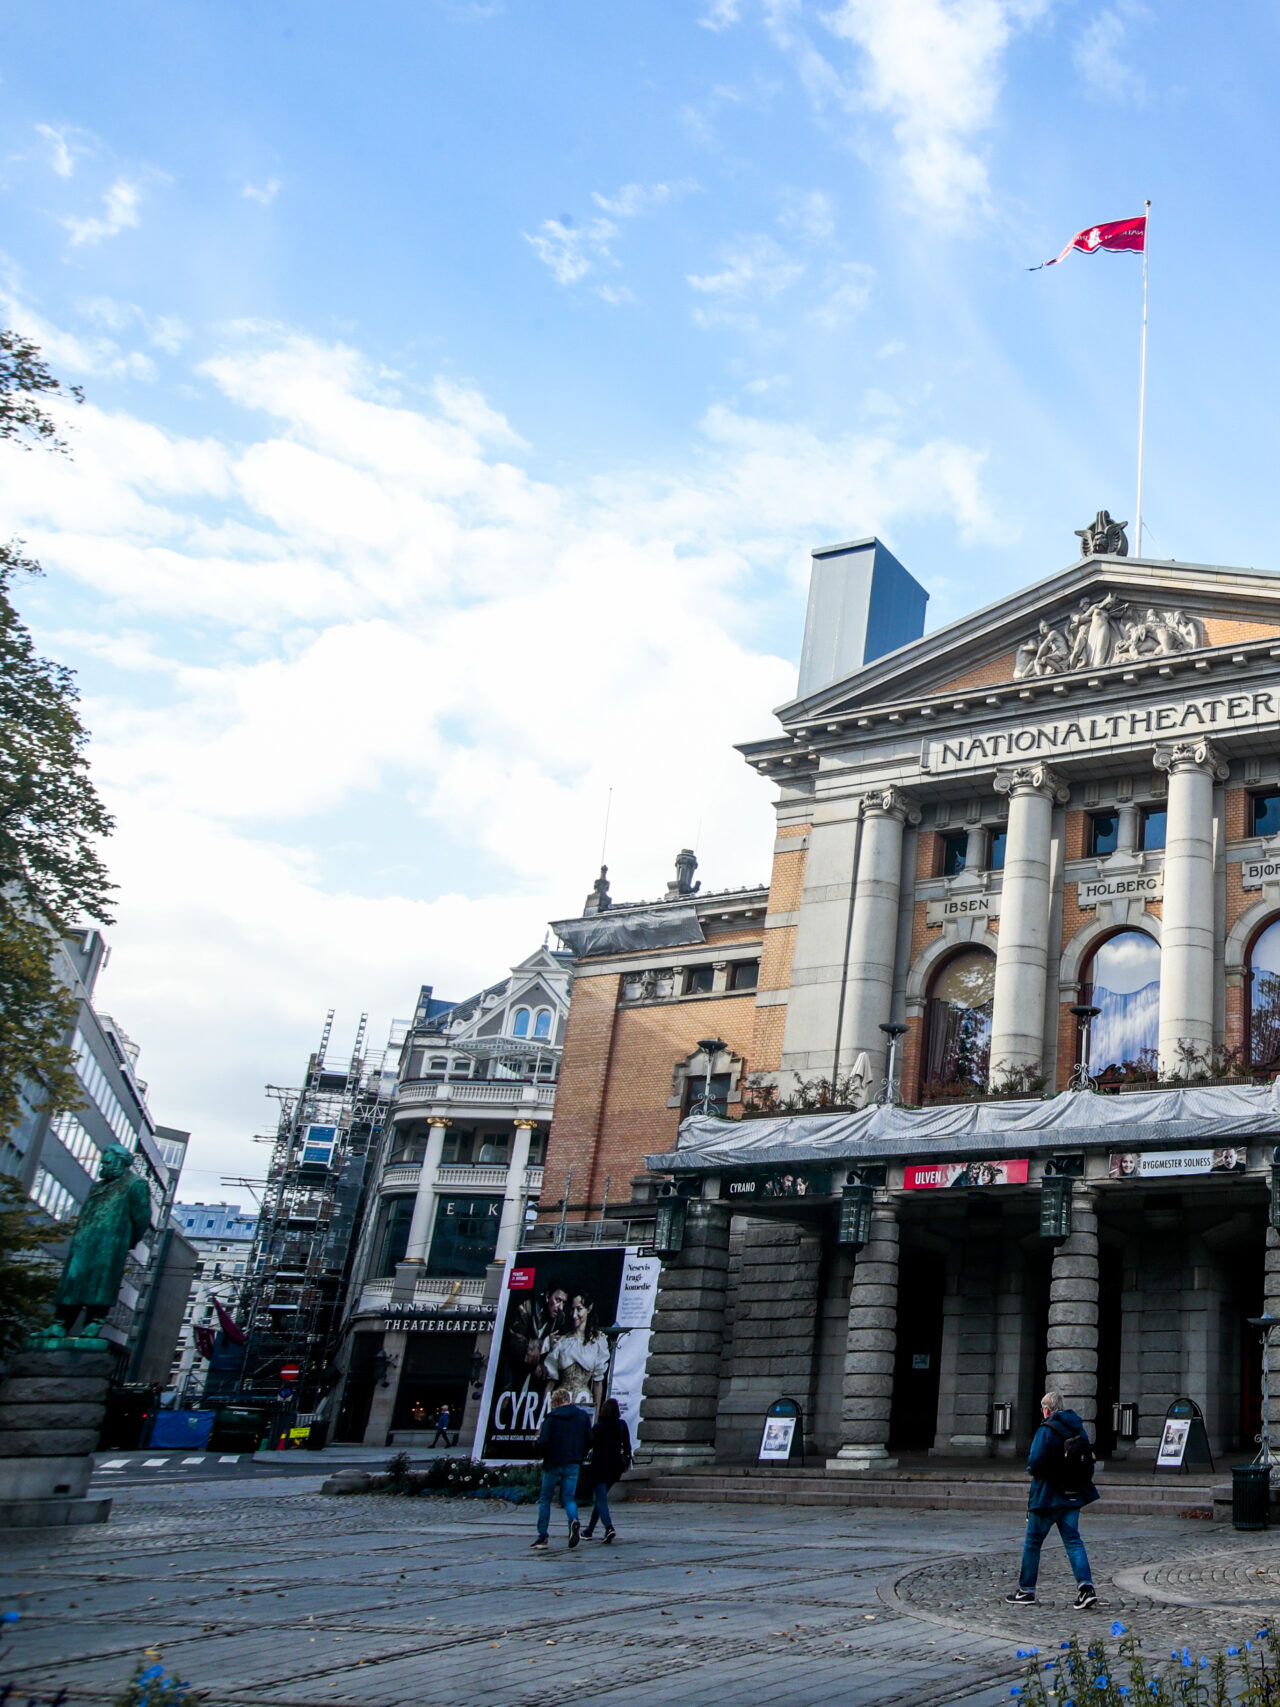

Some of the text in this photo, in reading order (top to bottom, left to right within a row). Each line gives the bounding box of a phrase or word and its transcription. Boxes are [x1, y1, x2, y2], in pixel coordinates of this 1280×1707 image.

[942, 692, 1275, 764] NATIONALTHEATER
[1085, 877, 1157, 897] HOLBERG
[943, 898, 989, 914] IBSEN
[1142, 1157, 1211, 1170] BYGGMESTER SOLNESS
[914, 1171, 942, 1185] ULVEN
[729, 1181, 756, 1194] CYRANO
[446, 1202, 499, 1216] EIK
[624, 1282, 651, 1291] komedie
[383, 1302, 438, 1313] ANNEN
[384, 1319, 496, 1332] THEATERCAFEEN
[494, 1391, 594, 1430] CYRA
